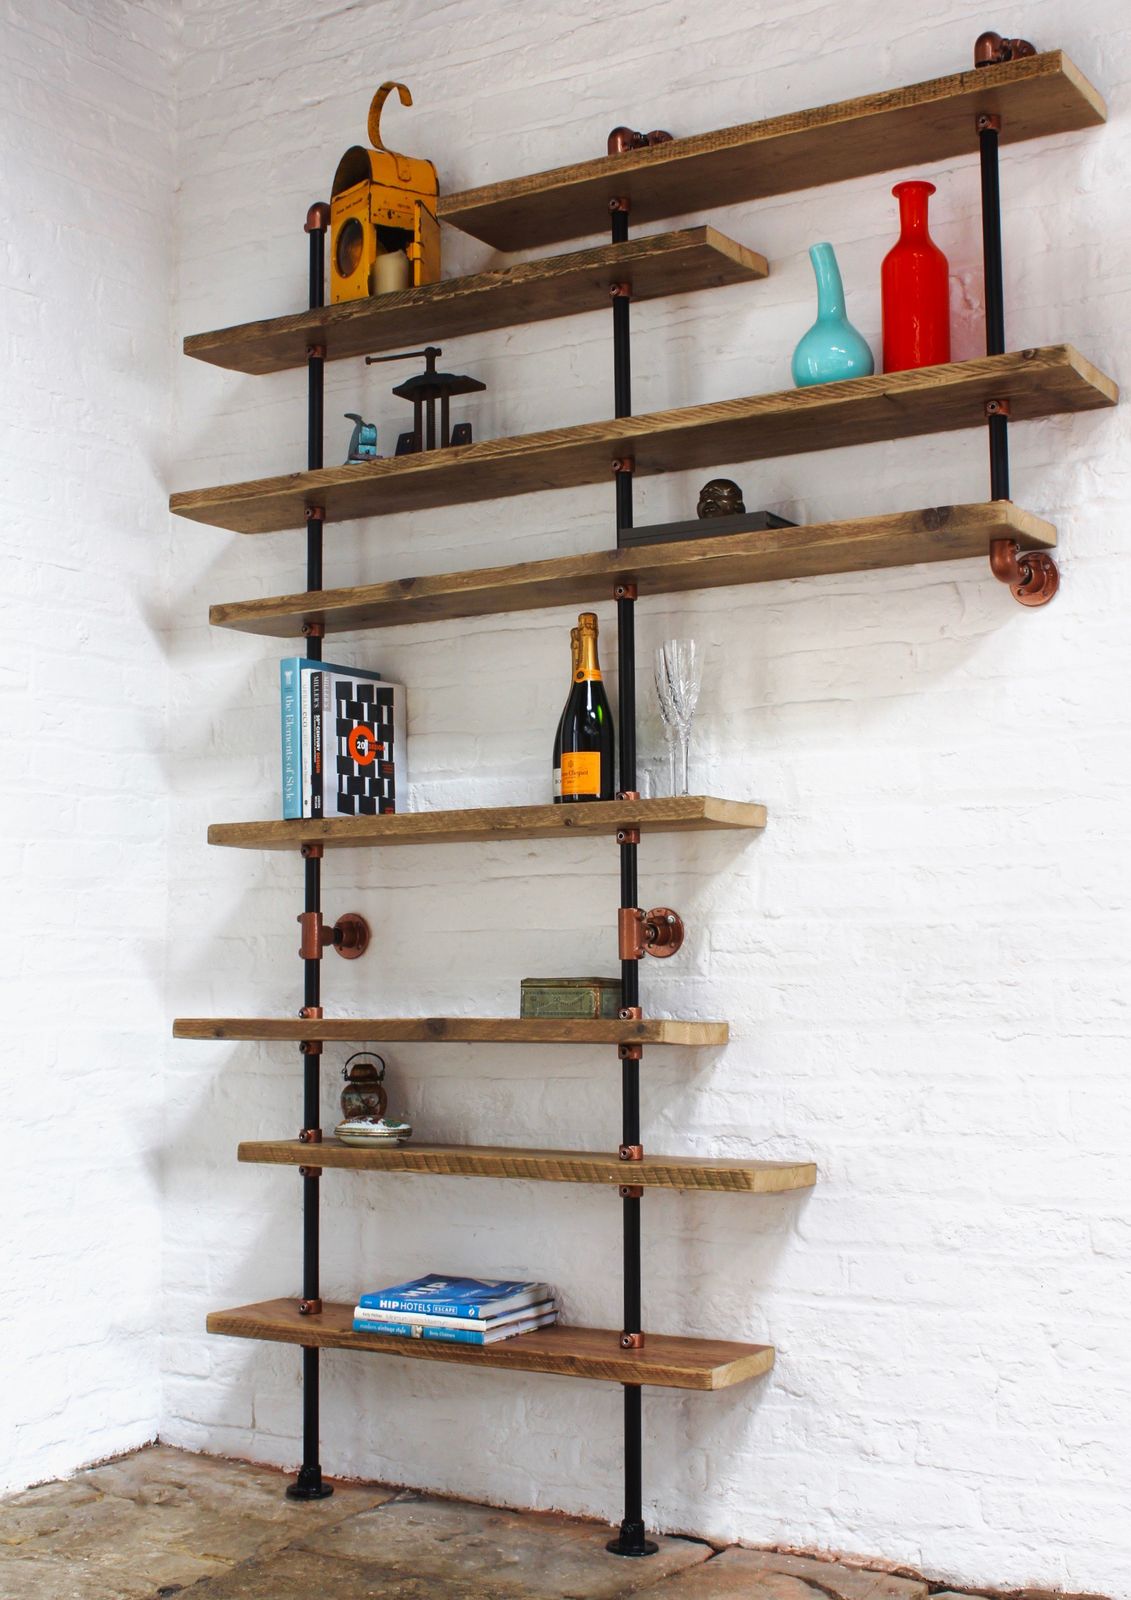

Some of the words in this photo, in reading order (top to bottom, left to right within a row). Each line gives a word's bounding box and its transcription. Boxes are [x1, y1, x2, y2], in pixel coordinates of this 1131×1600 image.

[285, 695, 294, 711] the
[285, 714, 294, 761] Elements
[286, 763, 295, 775] of
[286, 776, 295, 802] Style
[379, 1299, 400, 1309] HIP
[400, 1302, 431, 1313] HOTELS
